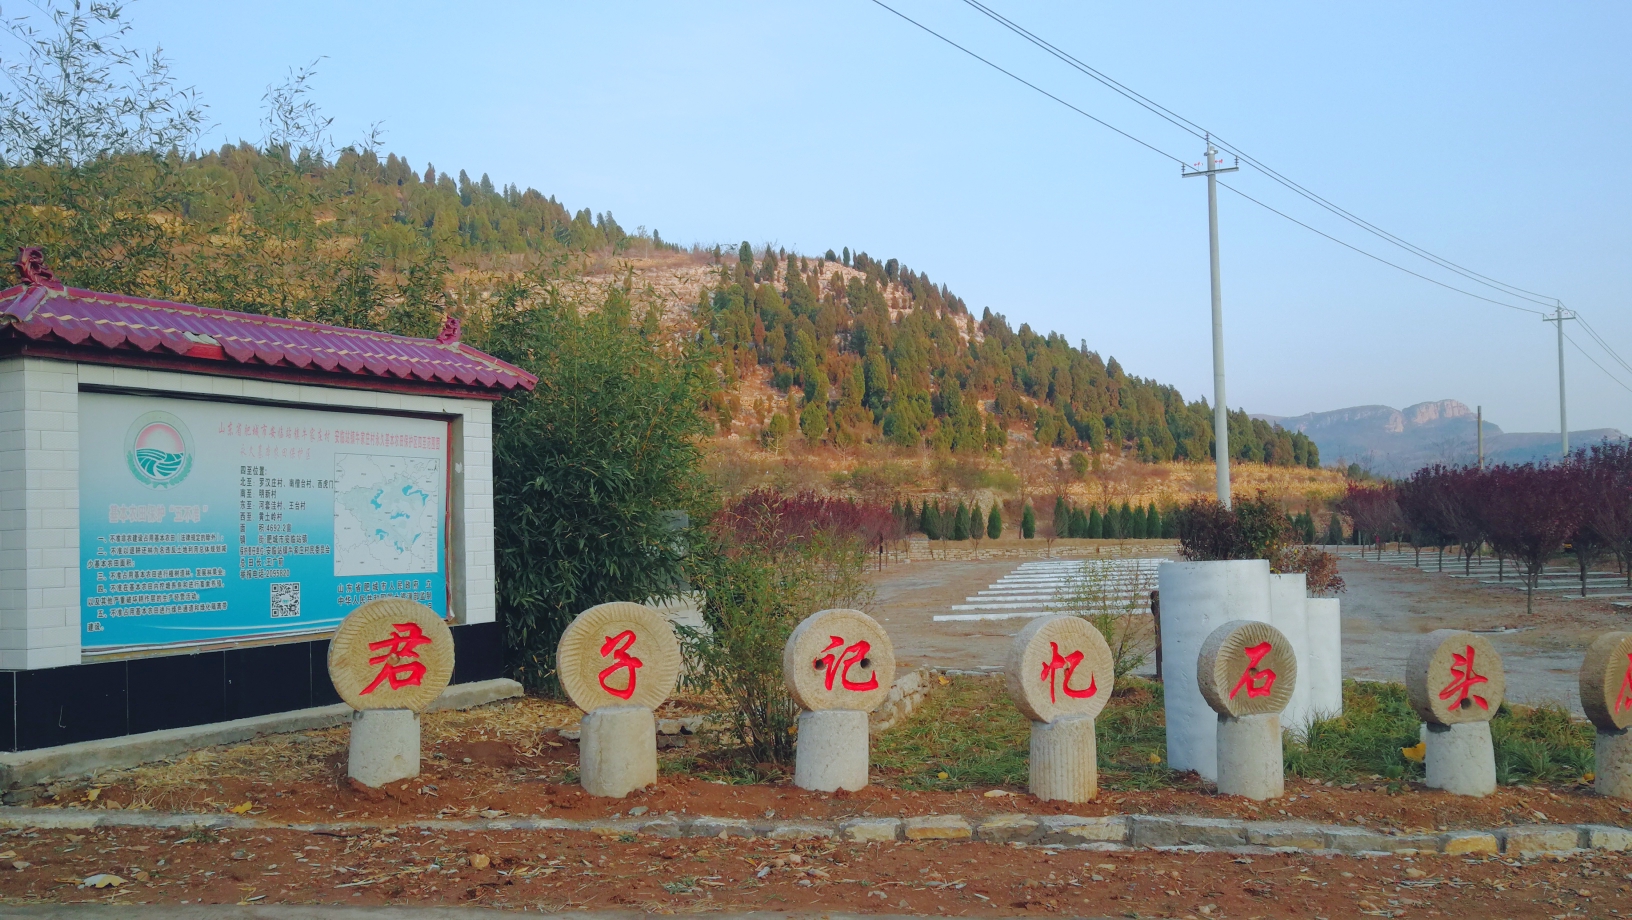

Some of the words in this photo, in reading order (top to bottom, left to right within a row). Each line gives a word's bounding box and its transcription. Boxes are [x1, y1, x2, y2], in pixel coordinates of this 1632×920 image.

[358, 621, 433, 696] 君
[597, 629, 643, 701] 子
[811, 635, 879, 692] 记
[1040, 641, 1098, 705] 忆
[1229, 641, 1277, 700] 石
[1438, 644, 1489, 712] 头
